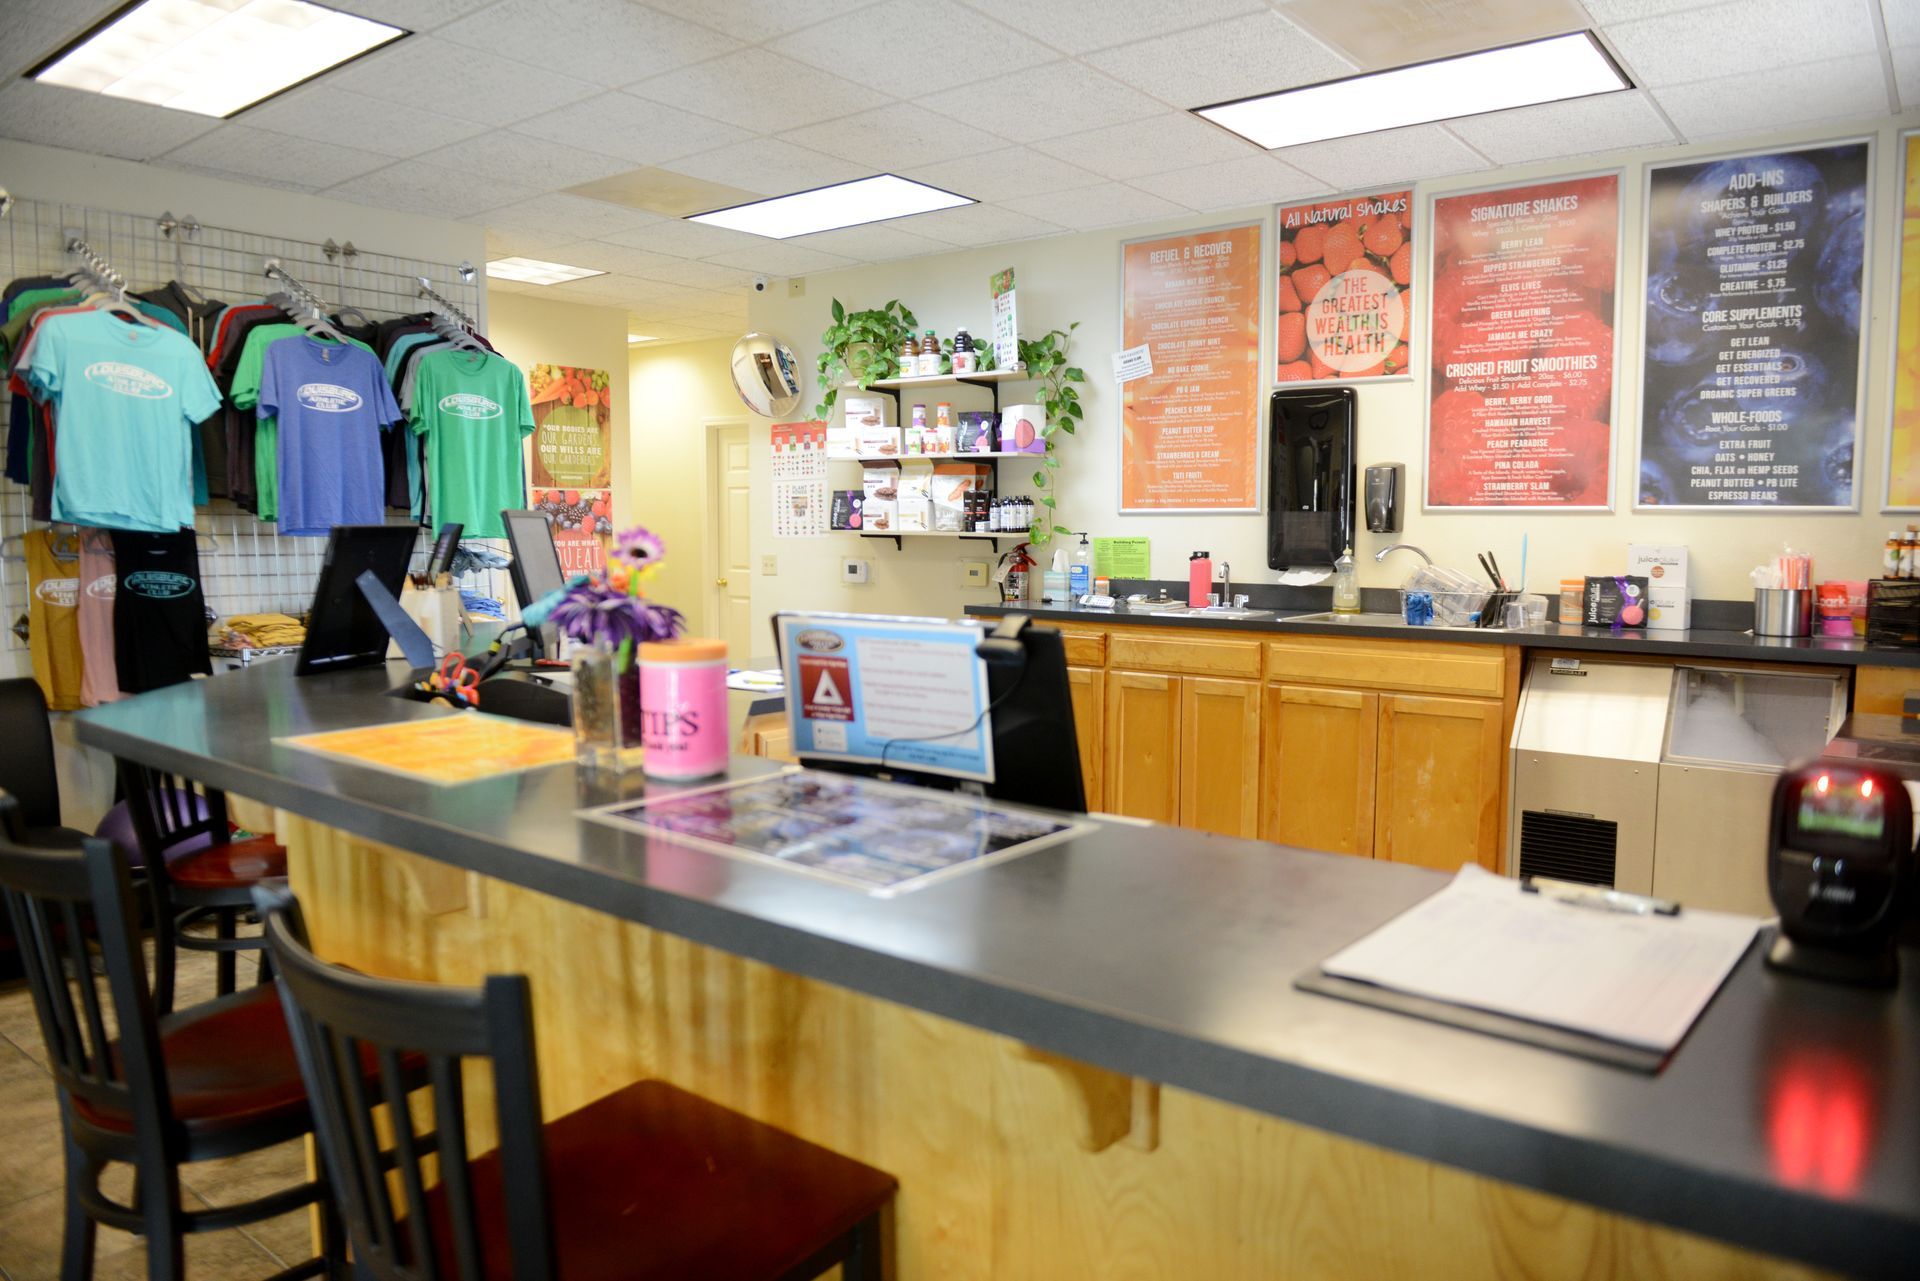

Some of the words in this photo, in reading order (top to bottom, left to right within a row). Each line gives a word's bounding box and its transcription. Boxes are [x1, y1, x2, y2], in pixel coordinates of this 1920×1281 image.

[1729, 169, 1784, 191] ADD-INS
[1700, 197, 1745, 213] SHAPERS
[1751, 196, 1758, 208] &
[1763, 190, 1813, 206] BUILDERS
[1470, 201, 1531, 222] SIGNATURE
[1532, 195, 1578, 215] SHAKES
[1285, 212, 1300, 229] All
[1304, 204, 1352, 225] Natural
[1715, 227, 1736, 238] WHEY
[1738, 224, 1768, 236] PROTEIN
[1775, 221, 1796, 232] $1.50
[1501, 239, 1523, 249] BERRY
[1525, 238, 1544, 247] LEAN
[1707, 244, 1744, 256] COMPLETE
[1746, 242, 1776, 253] PROTEIN
[1783, 239, 1804, 249] $2.75
[1150, 248, 1179, 264] REFUEL
[1184, 247, 1190, 258] &
[1194, 241, 1232, 258] RECOVER
[1483, 263, 1506, 272] DIPPED
[1508, 257, 1561, 270] STRAWBERRIES
[1720, 262, 1760, 273] GLUTAMINE
[1766, 259, 1788, 269] $1.25
[1198, 276, 1215, 284] BLAST
[1344, 277, 1367, 294] THE
[1720, 280, 1758, 292] CREATINE
[1501, 283, 1520, 292] ELVIS
[1521, 281, 1542, 290] LIVES
[1155, 300, 1182, 309] CHOCOLATE
[1204, 296, 1225, 304] CRUNCH
[1322, 293, 1388, 314] GREATEST
[1491, 310, 1512, 320] GREEN
[1514, 307, 1551, 318] LIGHTNING
[1702, 310, 1727, 323] CORE
[1730, 305, 1802, 321] SUPPLEMENTS
[1152, 321, 1179, 330] CHOCOLATE
[1180, 318, 1206, 327] ESPRESSO
[1208, 316, 1228, 324] CRUNCH
[1315, 313, 1370, 335] WEALTH
[1376, 312, 1388, 330] IS
[1702, 323, 1737, 332] Customize
[1756, 320, 1778, 328] Goals
[1488, 331, 1516, 341] JAMAICA
[1530, 329, 1553, 338] CRAZY
[1158, 340, 1185, 350] CHOCOLATE
[1324, 332, 1385, 356] HEALTH
[1731, 338, 1745, 347] GET
[1748, 336, 1770, 346] LEAN
[1719, 351, 1734, 361] GET
[1737, 349, 1781, 359] ENERGIZED
[1191, 364, 1209, 372] COOKIE
[1446, 361, 1494, 378] CRUSHED
[1497, 359, 1529, 374] FRUIT
[1531, 355, 1597, 372] SMOOTHIES
[1716, 364, 1731, 373] GET
[1734, 362, 1782, 372] ESSENTIALS
[1459, 376, 1485, 385] Delicious
[1501, 374, 1531, 382] Smoothies
[1716, 377, 1732, 386] GET
[1734, 375, 1780, 386] RECOVERED
[1469, 384, 1486, 393] Whey
[1492, 383, 1509, 391] $1.50
[1532, 380, 1562, 388] Complete
[1700, 390, 1735, 399] ORGANIC
[1737, 388, 1762, 398] SUPER
[1765, 387, 1797, 397] GREENS
[1510, 396, 1532, 405] BERRY
[1534, 395, 1552, 404] GOOD
[1165, 406, 1187, 414] PEACHES
[1194, 405, 1212, 414] CREAM
[1485, 418, 1518, 428] HAWAIIAN
[1519, 417, 1551, 426] HARVEST
[1712, 410, 1782, 424] WHOLE-FOODS
[1768, 423, 1788, 432] $1.00
[542, 431, 556, 444] OUR
[1487, 440, 1508, 448] PEACH
[1510, 439, 1548, 447] PEARADISE
[541, 445, 557, 453] OUR
[560, 446, 584, 454] WILLS
[587, 447, 601, 455] ARE
[1720, 440, 1745, 449] EXTRA
[1748, 440, 1771, 448] FRUIT
[1715, 453, 1735, 462] OATS
[1748, 452, 1775, 462] HONEY
[1691, 466, 1712, 476] CHIA,
[1715, 466, 1735, 475] FLAX
[1748, 466, 1770, 474] HEMP
[1772, 465, 1799, 474] SEEDS
[1483, 482, 1528, 490] STRAWBERRY
[1530, 482, 1549, 490] SLAM
[1691, 478, 1721, 488] PEANUT
[1723, 478, 1754, 487] BUTTER
[1766, 478, 1778, 487] PB
[1780, 478, 1798, 487] LITE
[1708, 492, 1748, 500] ESPRESSO
[1751, 491, 1778, 500] BEANS
